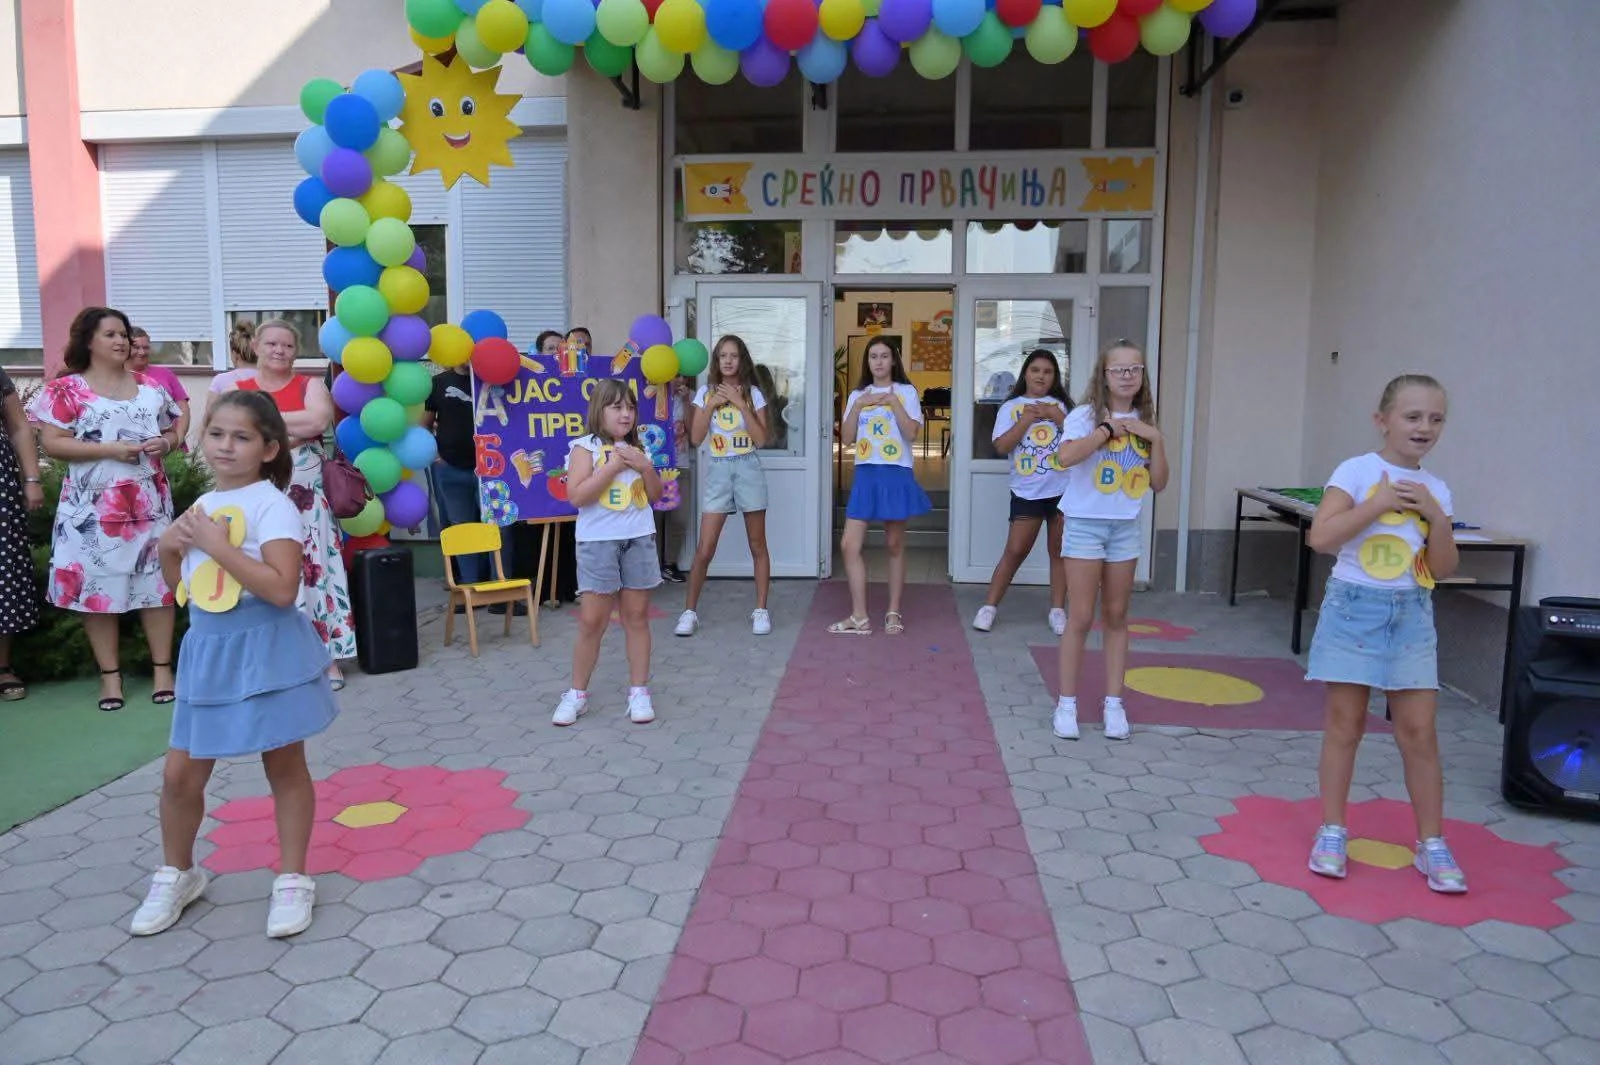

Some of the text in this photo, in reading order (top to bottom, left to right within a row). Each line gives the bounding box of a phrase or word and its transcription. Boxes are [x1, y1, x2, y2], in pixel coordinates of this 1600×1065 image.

[762, 162, 1067, 210] СРЕЌНО ПРВАЧИЊА
[506, 377, 563, 404] ЈАС
[528, 412, 585, 437] ПРВ
[873, 423, 884, 436] К
[732, 436, 749, 449] Ш
[883, 444, 898, 457] Ф
[473, 433, 506, 478] Б
[1021, 457, 1032, 470] П
[1101, 467, 1115, 485] В
[480, 479, 519, 527] В
[610, 488, 622, 504] Е
